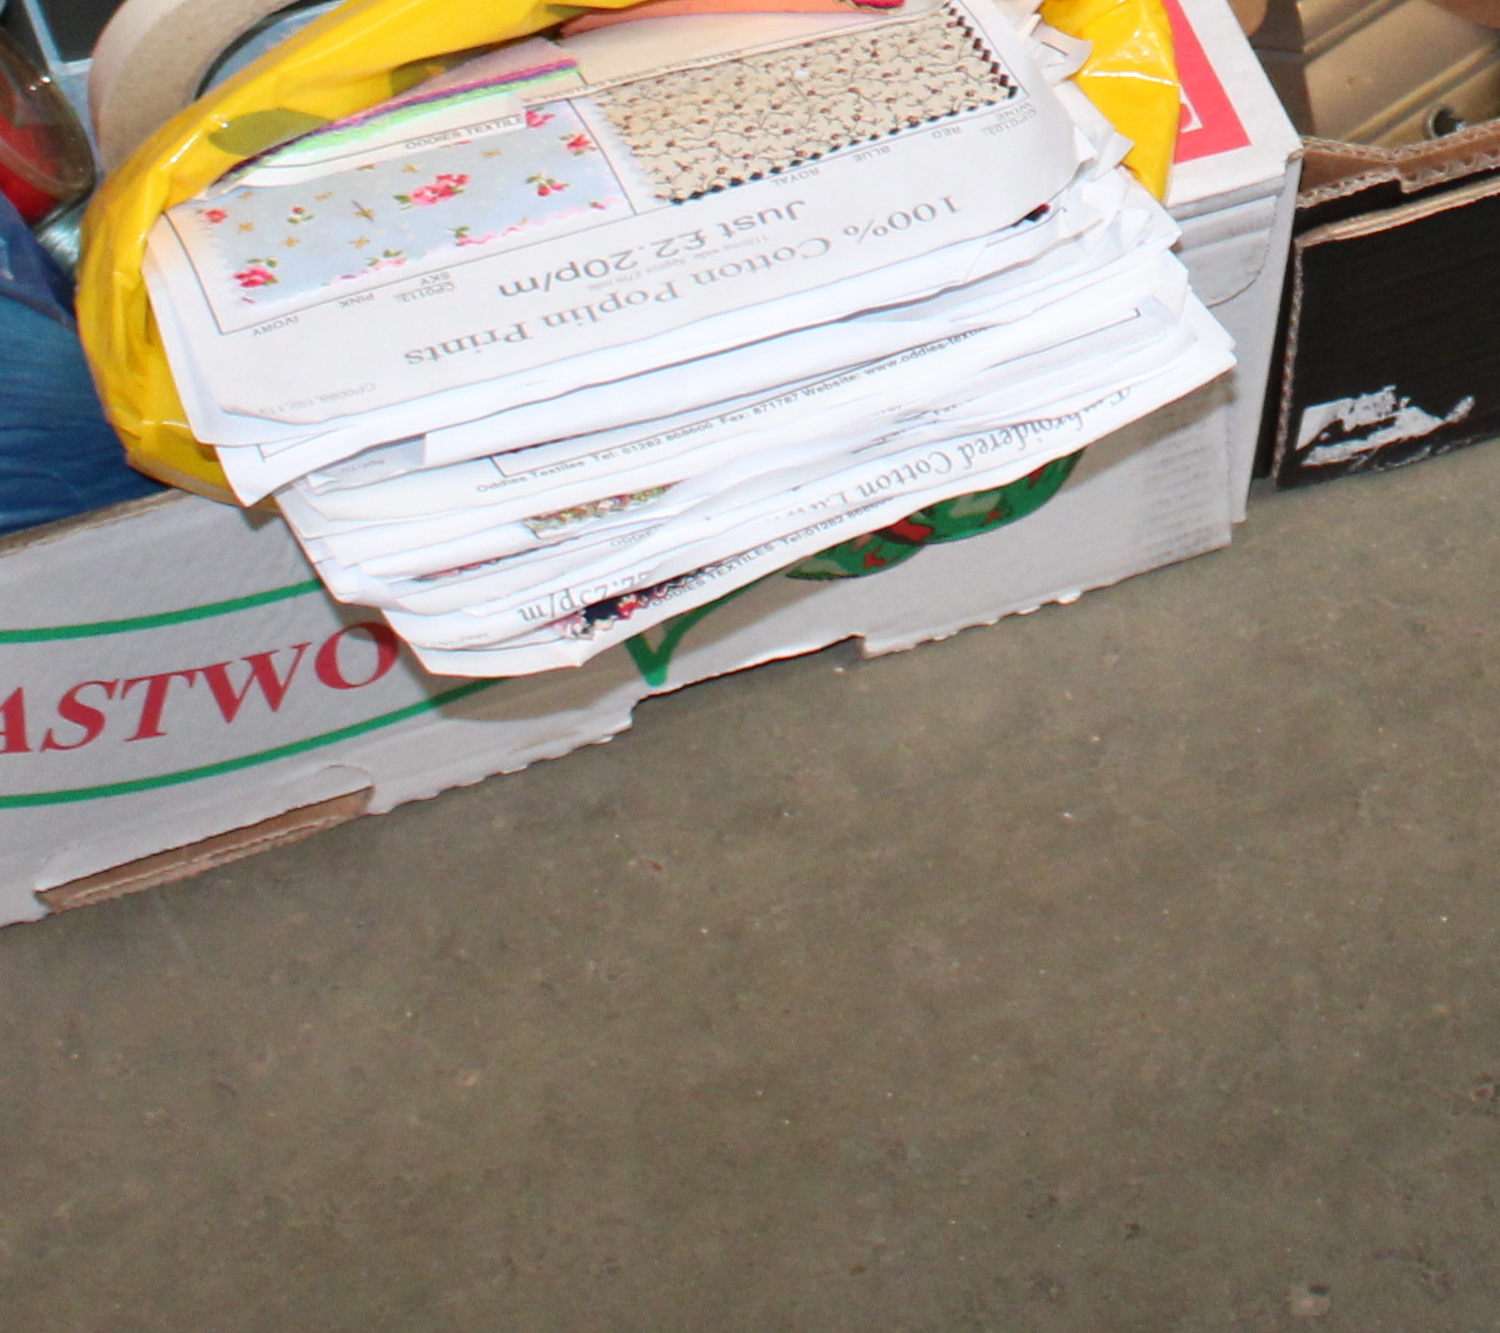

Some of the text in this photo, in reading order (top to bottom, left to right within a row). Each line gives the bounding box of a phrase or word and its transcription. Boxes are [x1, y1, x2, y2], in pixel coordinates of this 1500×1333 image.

[931, 125, 962, 140] RED
[852, 144, 892, 164] BLUE
[771, 166, 821, 187] ROYAL
[496, 198, 807, 300] Just £2.20p/m
[403, 193, 963, 367] 100% Cotton Poplin Prints
[420, 271, 452, 287] SKY
[340, 291, 376, 310] PINK
[252, 314, 300, 337] IVORY
[475, 474, 528, 494] Oddies
[531, 459, 586, 480] Textiles
[591, 448, 619, 464] Tel:
[622, 437, 662, 456] 01282
[719, 410, 752, 425] Fax:
[801, 371, 862, 398] Website:
[856, 449, 953, 499] Cotton
[707, 544, 775, 583] TEXTILES
